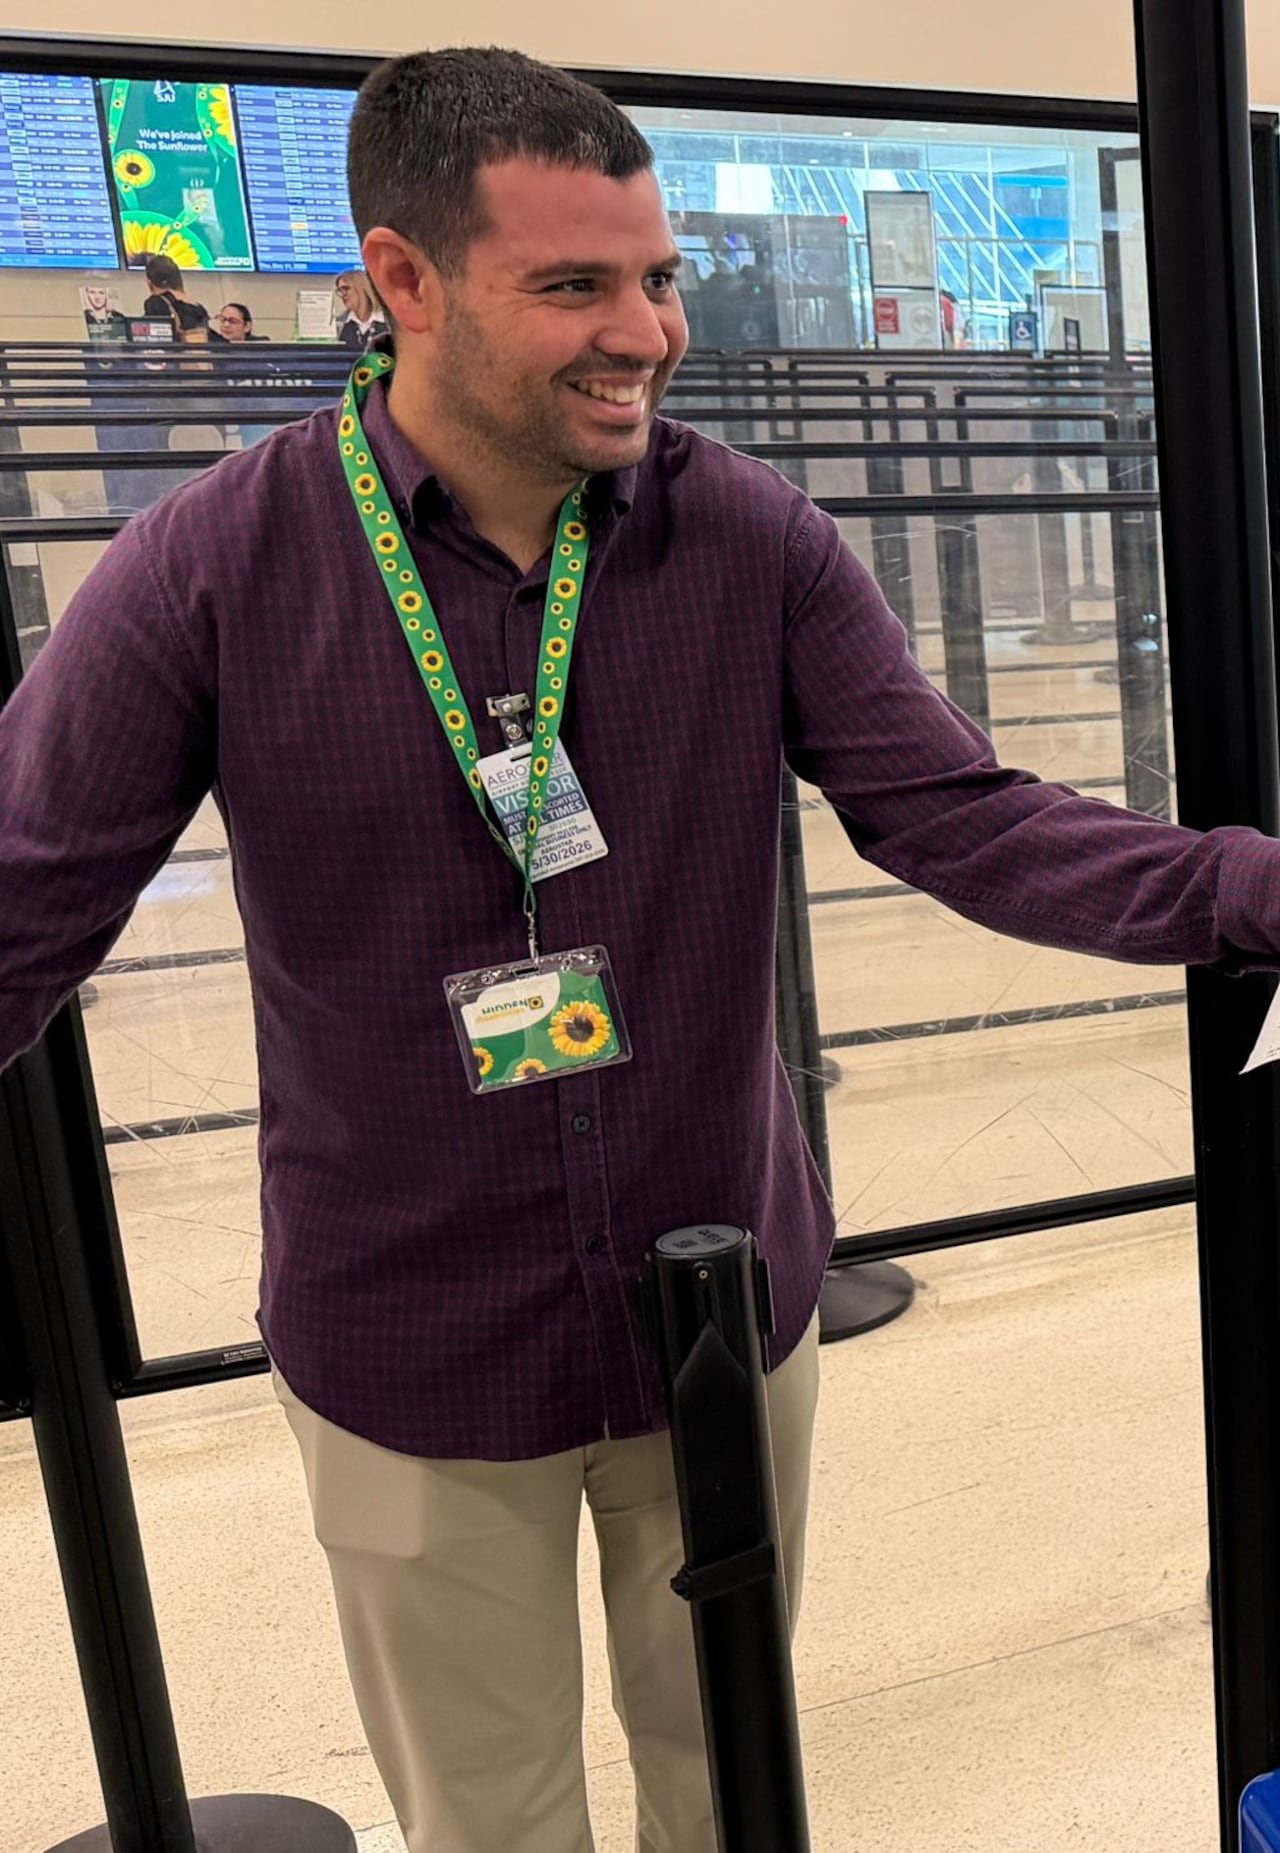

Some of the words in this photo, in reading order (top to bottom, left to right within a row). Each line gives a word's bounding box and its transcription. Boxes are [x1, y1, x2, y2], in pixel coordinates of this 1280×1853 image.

[136, 140, 157, 150] The
[158, 141, 207, 152] Sunflower
[171, 130, 202, 141] joined
[495, 775, 577, 813] VISOR
[508, 823, 522, 836] AT
[546, 800, 584, 819] TIMES
